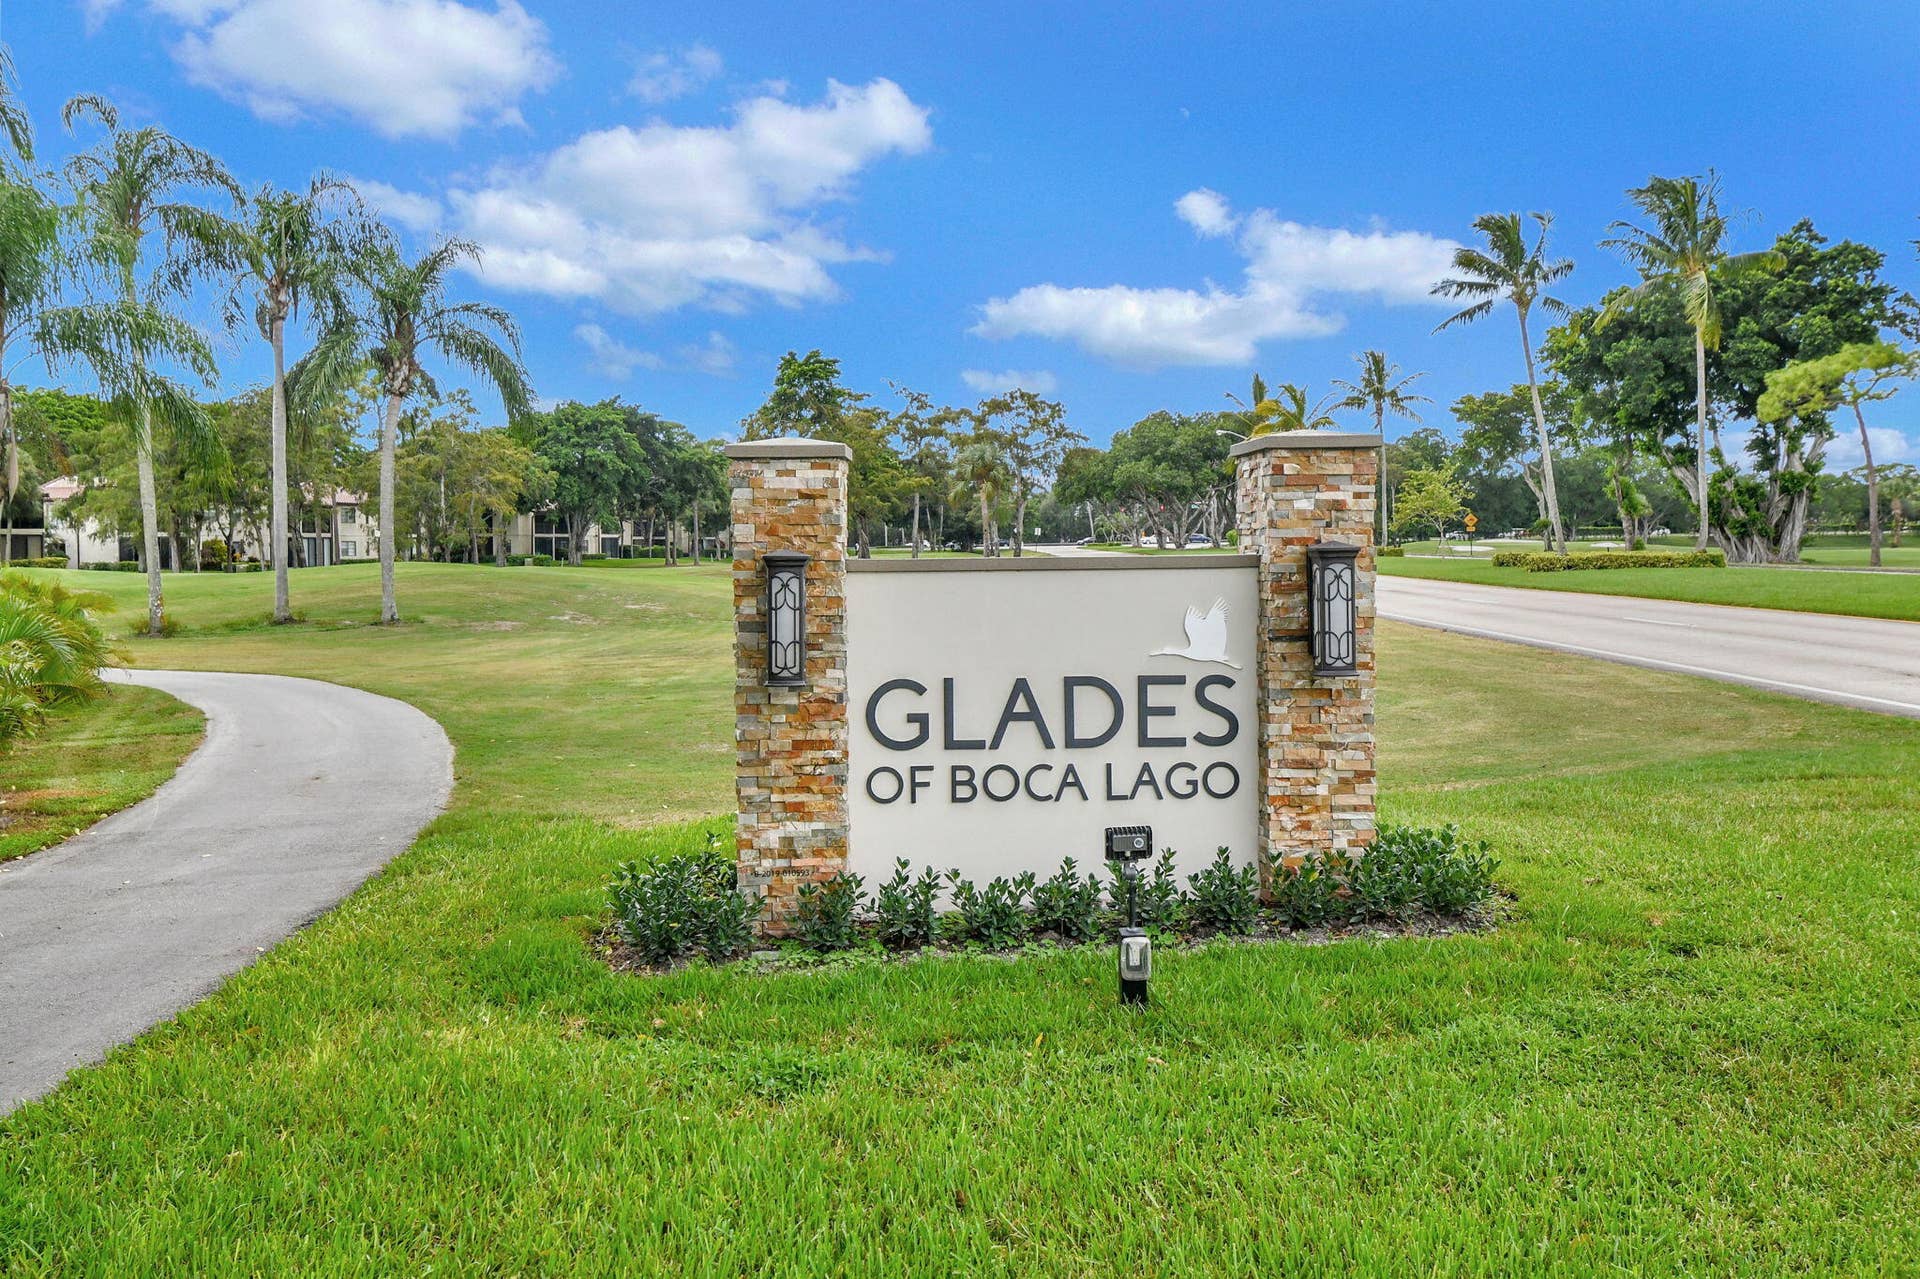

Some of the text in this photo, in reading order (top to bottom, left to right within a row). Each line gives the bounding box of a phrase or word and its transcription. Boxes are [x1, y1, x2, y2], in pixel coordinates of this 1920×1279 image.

[866, 675, 1239, 751] GLADES
[866, 762, 1240, 804] OF BOCA LAGO
